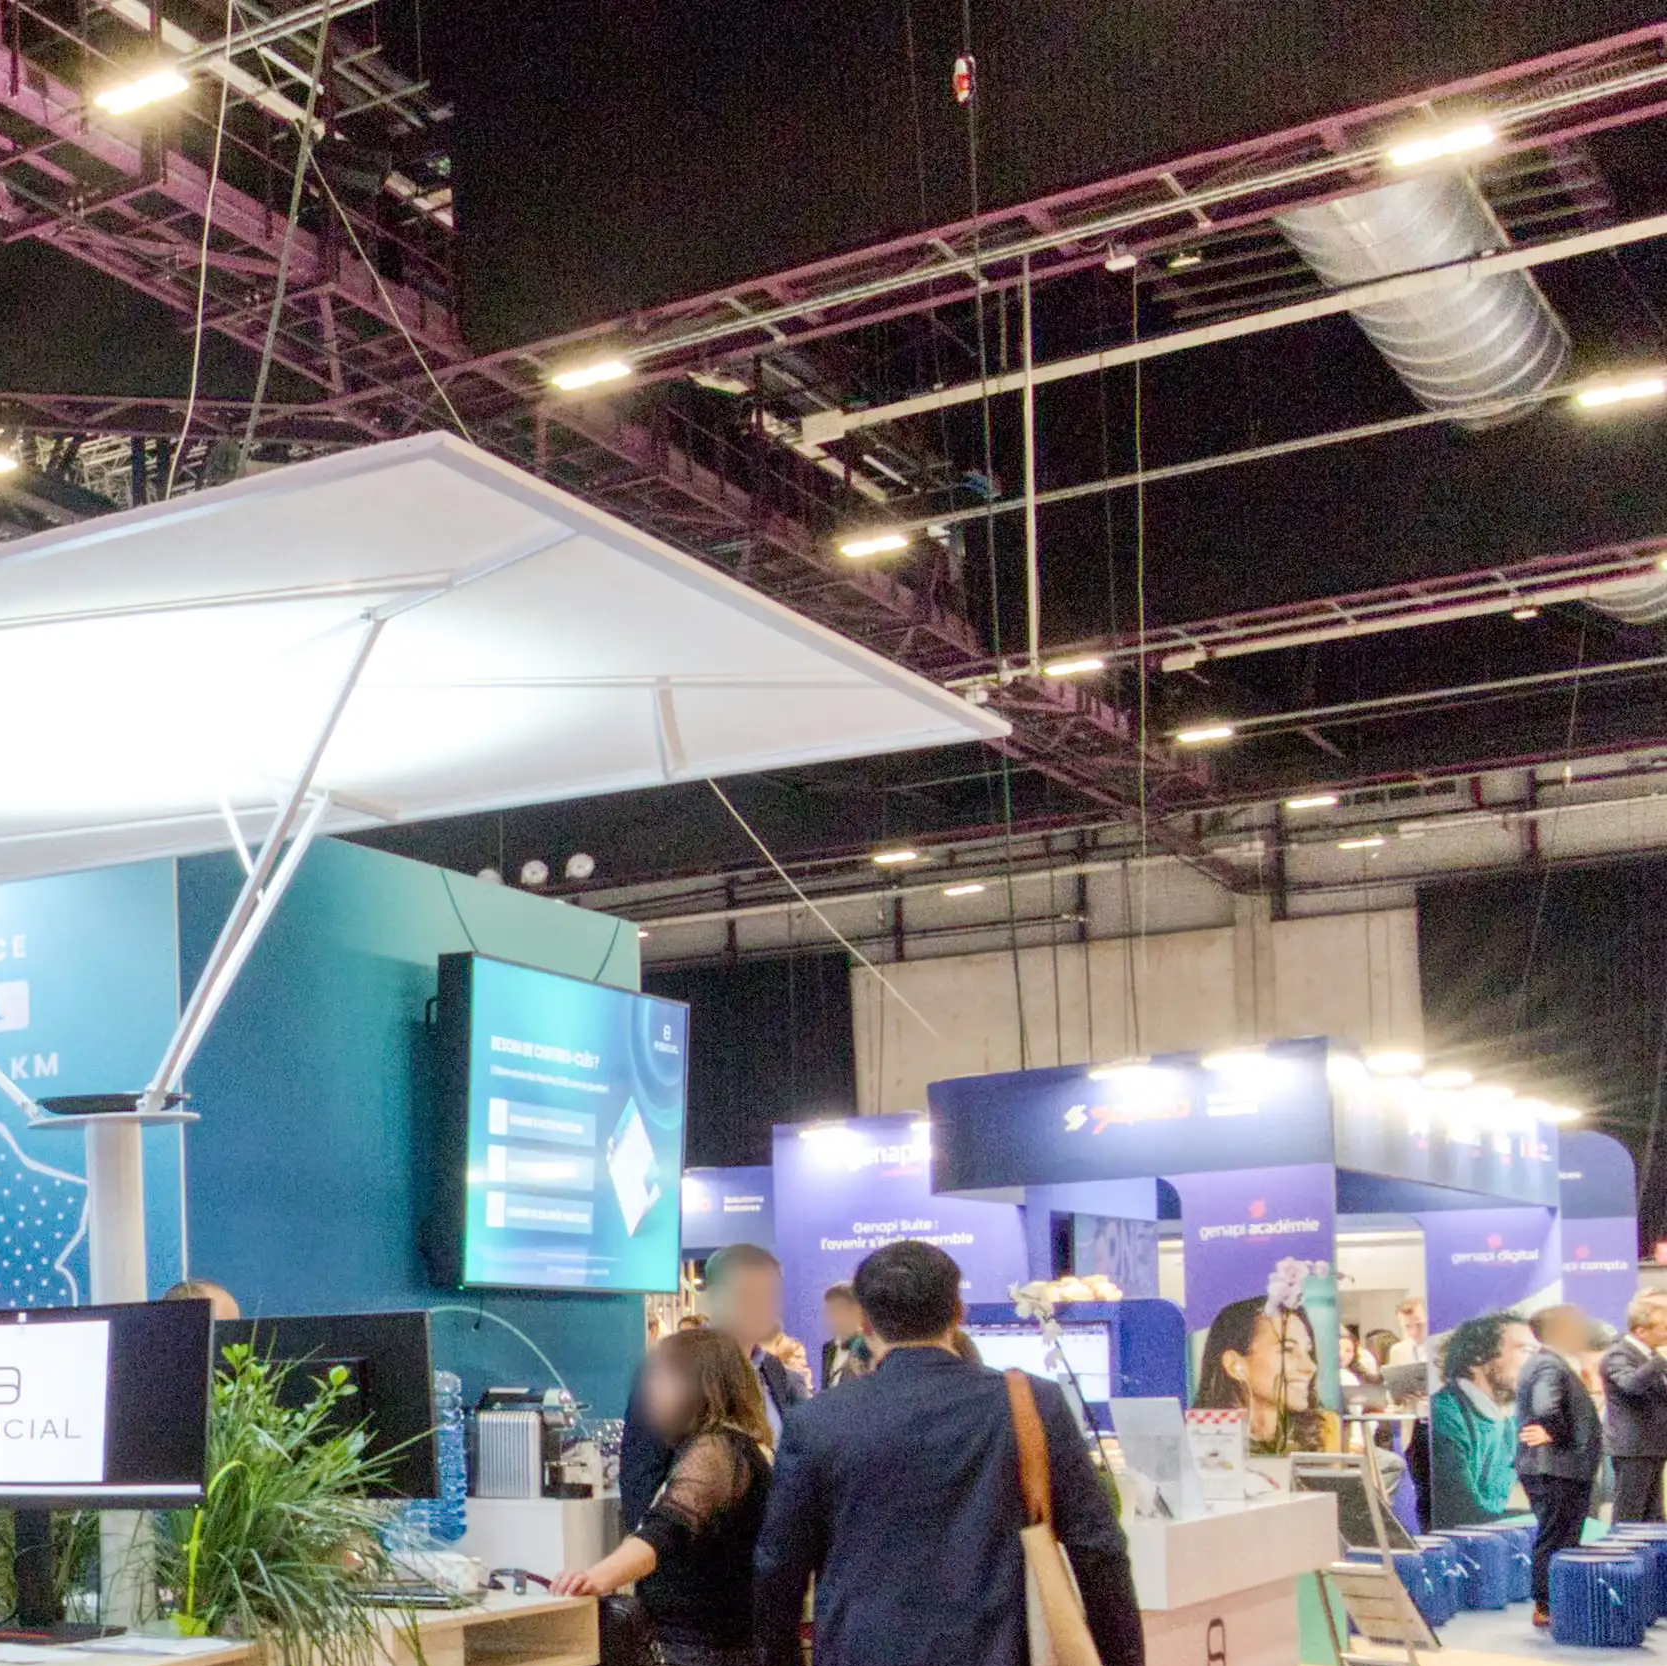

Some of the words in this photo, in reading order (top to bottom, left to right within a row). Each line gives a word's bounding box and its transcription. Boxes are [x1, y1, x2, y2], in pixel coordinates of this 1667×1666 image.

[10, 1051, 60, 1081] KM
[900, 1218, 932, 1231] Suite
[1199, 1222, 1245, 1241] genapi
[1248, 1217, 1320, 1236] académie
[1498, 1248, 1539, 1263] digital
